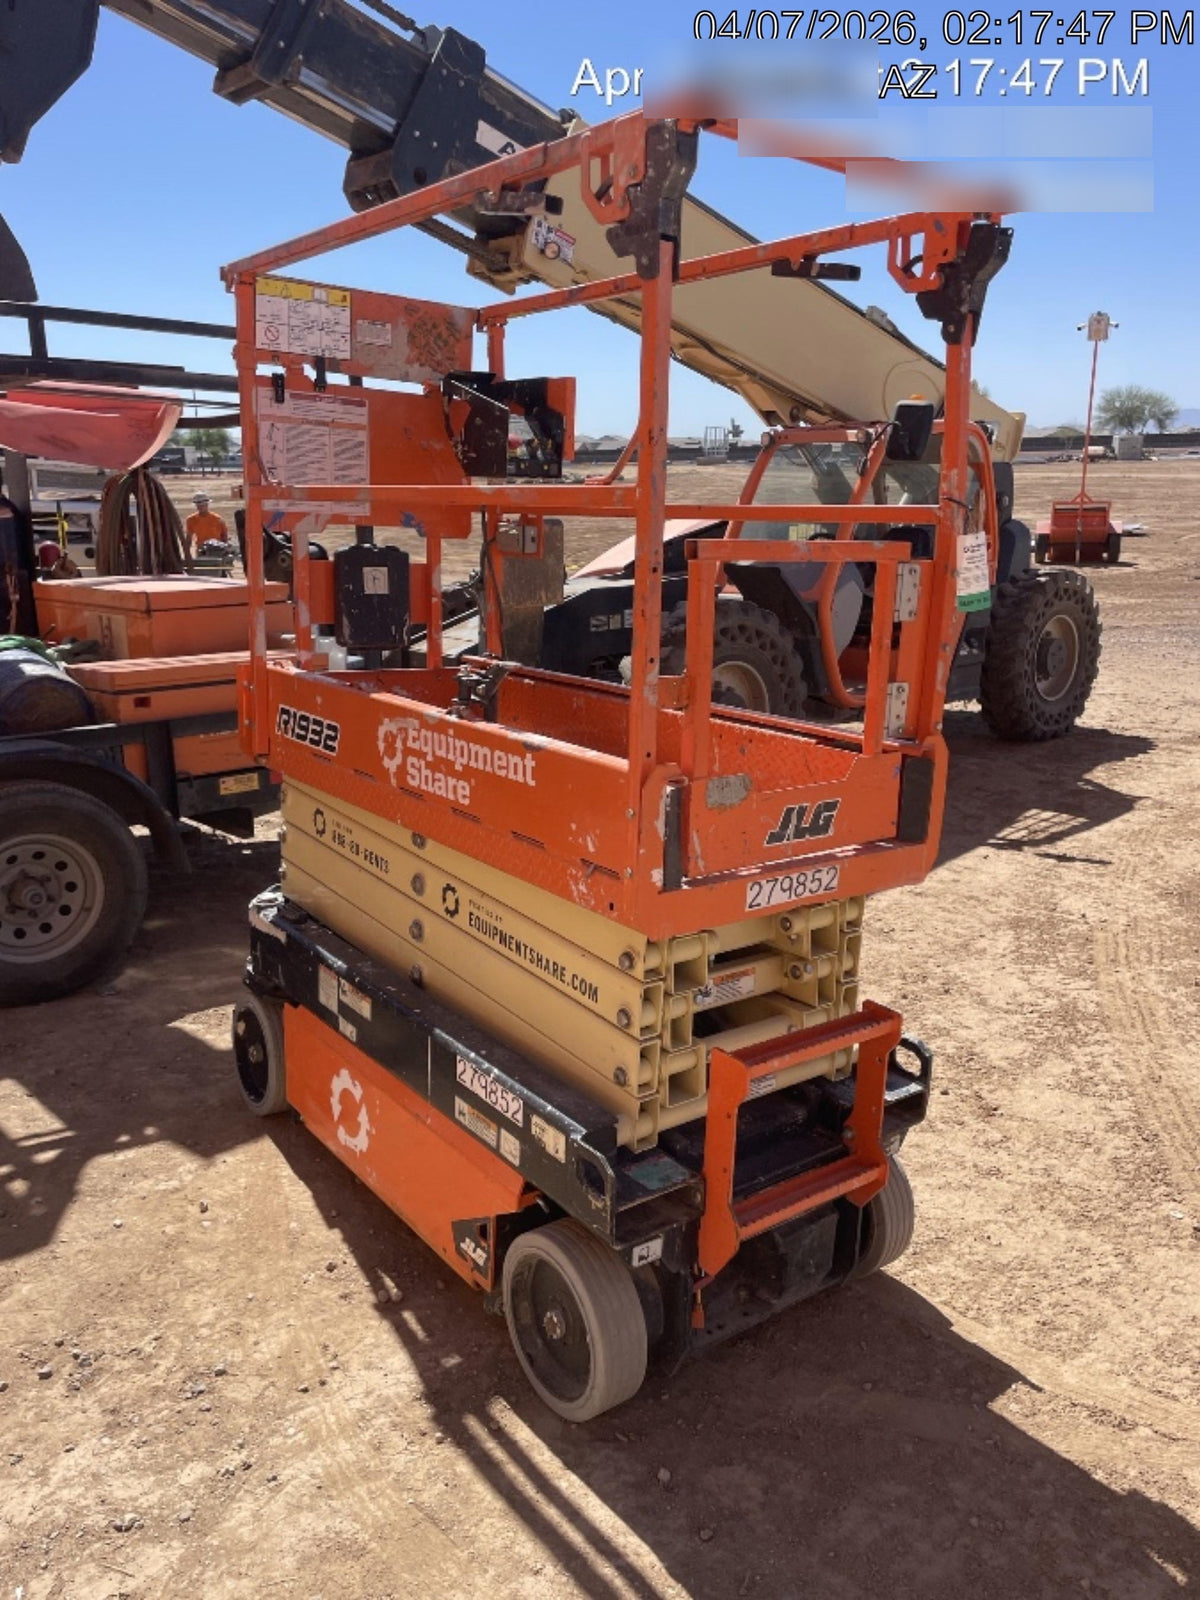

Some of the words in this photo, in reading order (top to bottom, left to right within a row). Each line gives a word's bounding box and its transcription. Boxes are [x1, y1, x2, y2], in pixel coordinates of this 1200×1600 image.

[276, 706, 338, 753] R1932
[407, 723, 536, 786] Equipment
[407, 757, 470, 806] Share
[764, 798, 842, 847] JLG
[747, 866, 839, 910] 279852
[468, 911, 600, 1004] EQUIPMENTSHARE.COM
[457, 1058, 523, 1126] 279852
